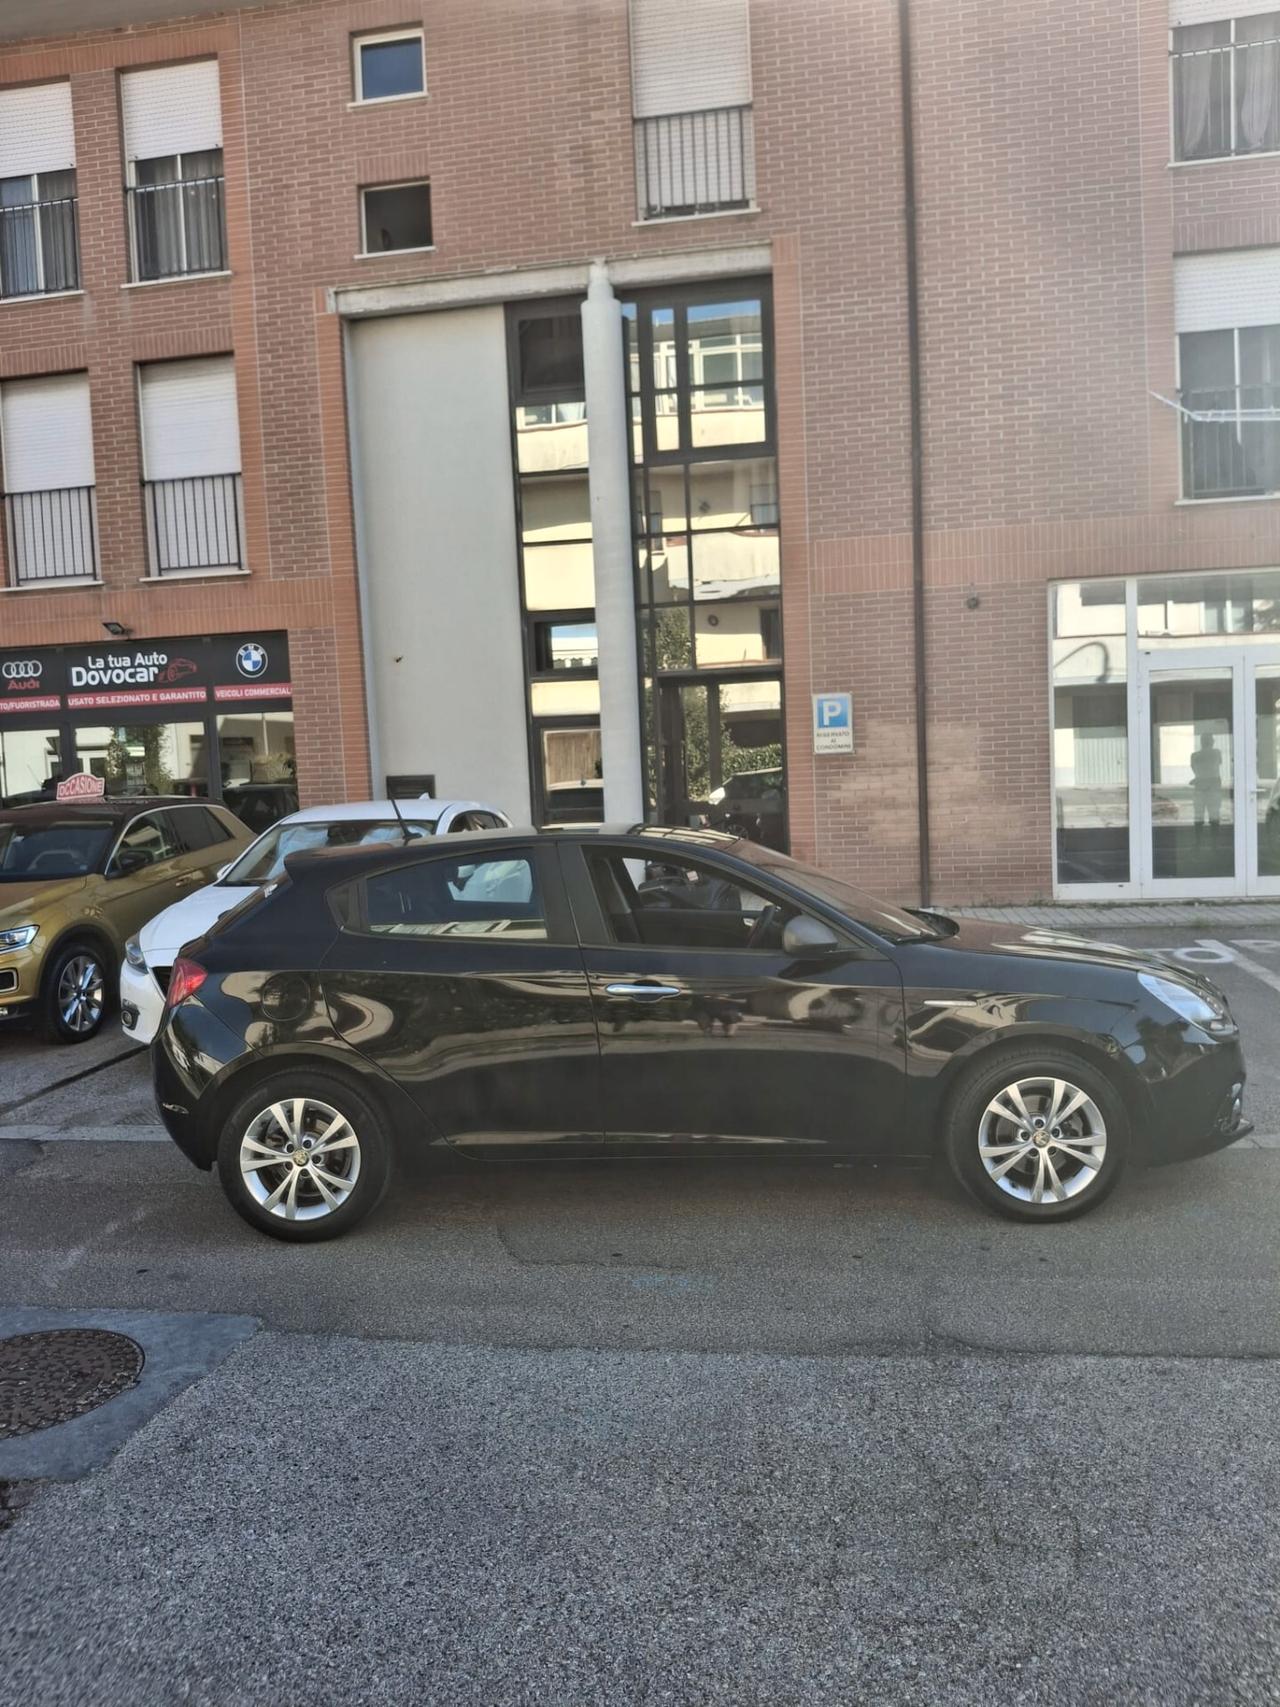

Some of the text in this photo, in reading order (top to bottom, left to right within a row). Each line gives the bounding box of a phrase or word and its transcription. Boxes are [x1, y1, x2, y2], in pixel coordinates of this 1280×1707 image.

[87, 651, 168, 669] La tua Auto
[8, 677, 40, 690] Audi
[71, 666, 159, 687] Dovocar
[68, 690, 207, 706] USATO SELEZIONATO E GARANTITO
[215, 689, 243, 698] VEICOLI
[823, 701, 842, 725] P
[59, 775, 102, 795] OCCASIONE
